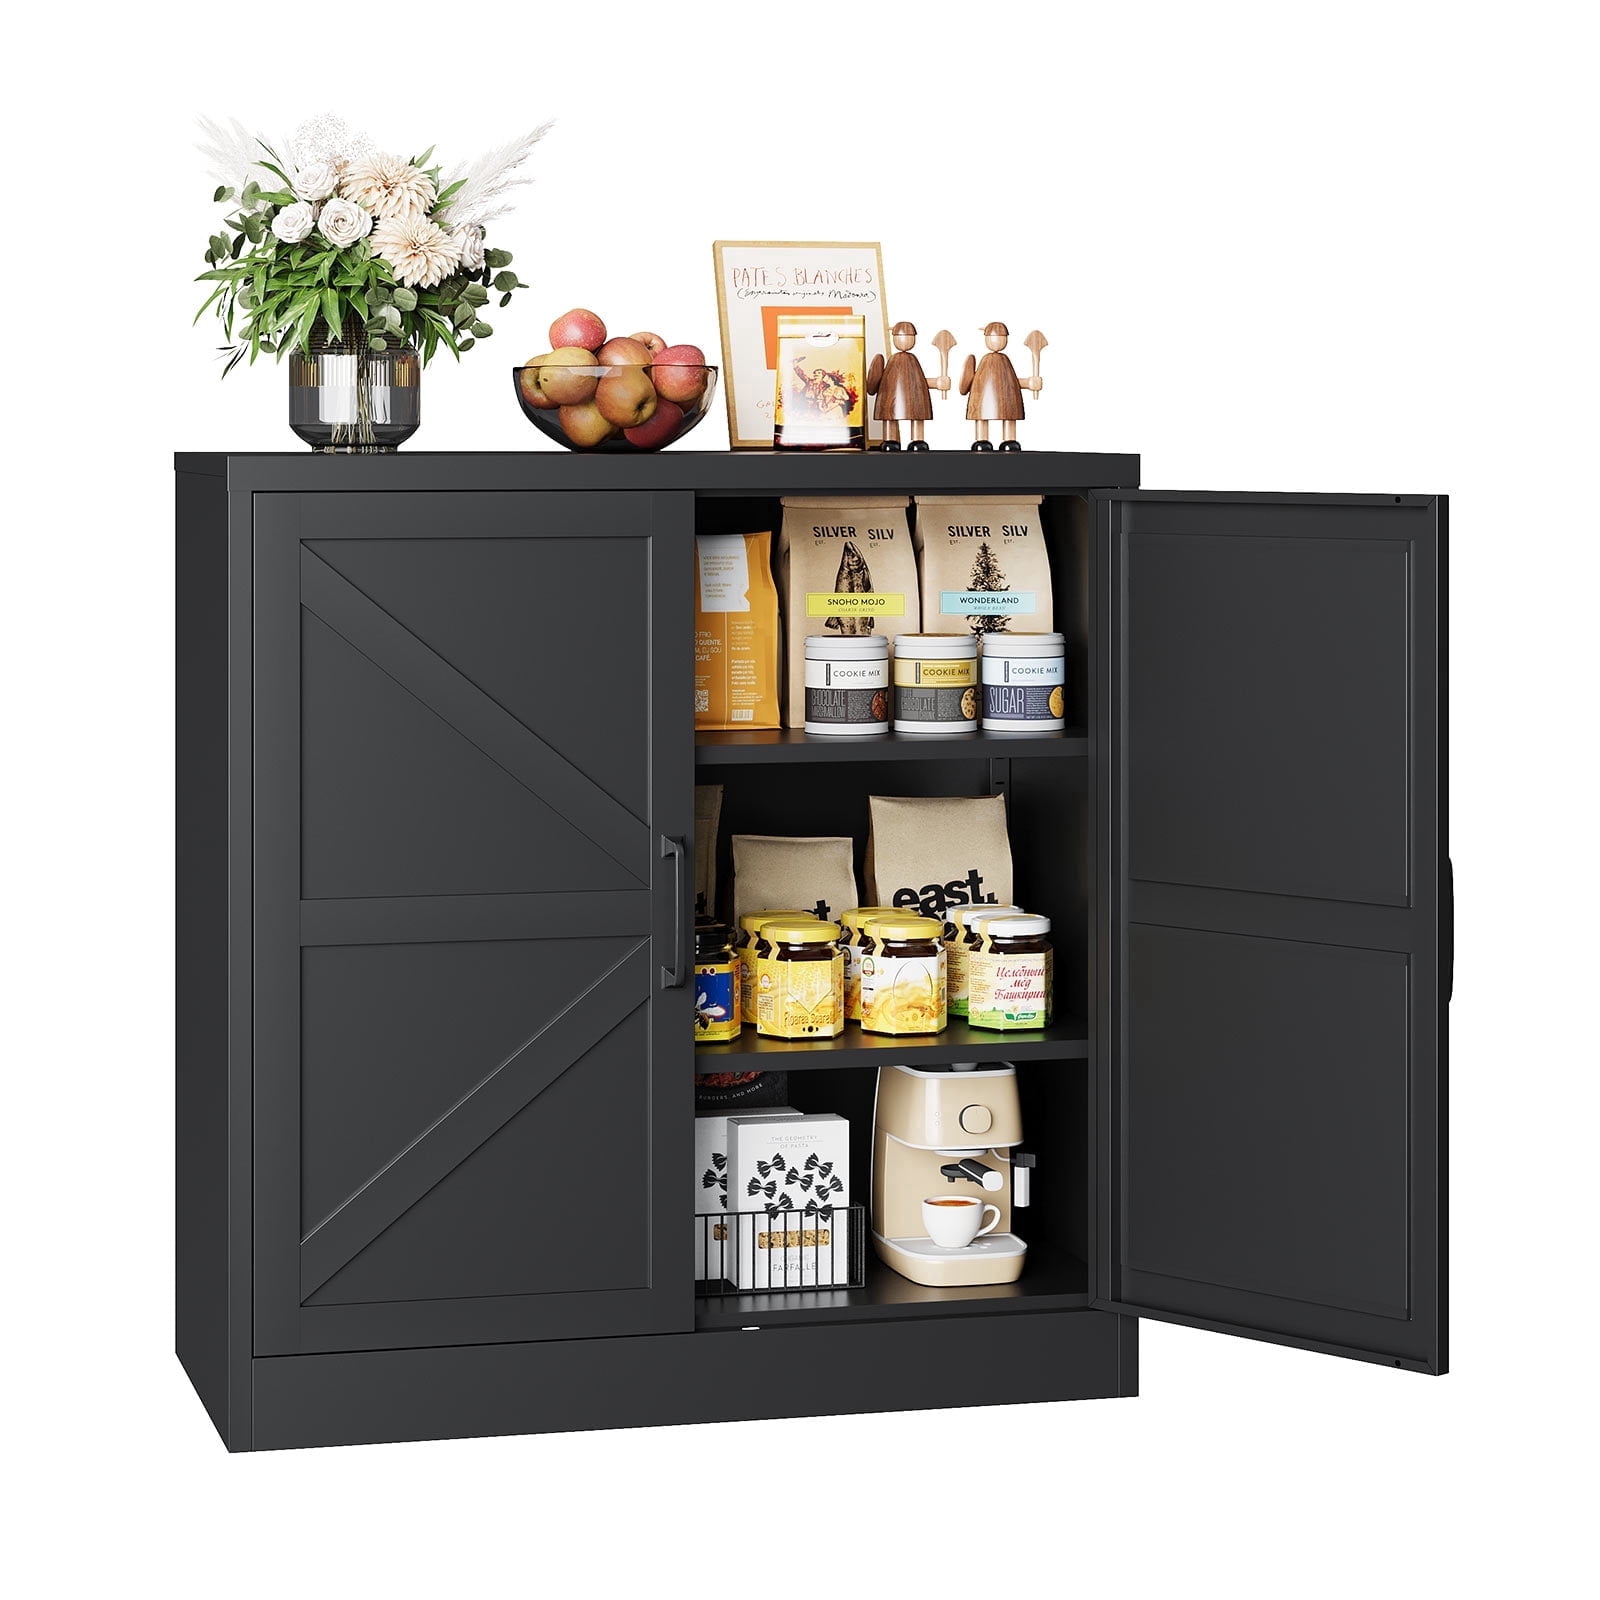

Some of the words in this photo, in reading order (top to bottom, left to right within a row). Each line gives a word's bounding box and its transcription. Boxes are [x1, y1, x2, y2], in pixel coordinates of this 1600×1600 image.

[793, 266, 873, 286] BLANCHES
[812, 526, 857, 538] SILVER
[867, 528, 894, 540] SILV
[947, 525, 991, 537] SILVER
[1001, 524, 1028, 537] SILV
[827, 598, 859, 606] SNOHO
[860, 598, 886, 606] MOJO
[959, 596, 1020, 604] WONDERLAND
[922, 668, 956, 676] COOKIE
[1011, 667, 1045, 675] COOKIE
[989, 686, 1025, 714] SUGAR
[772, 1262, 817, 1272] FARFALE
